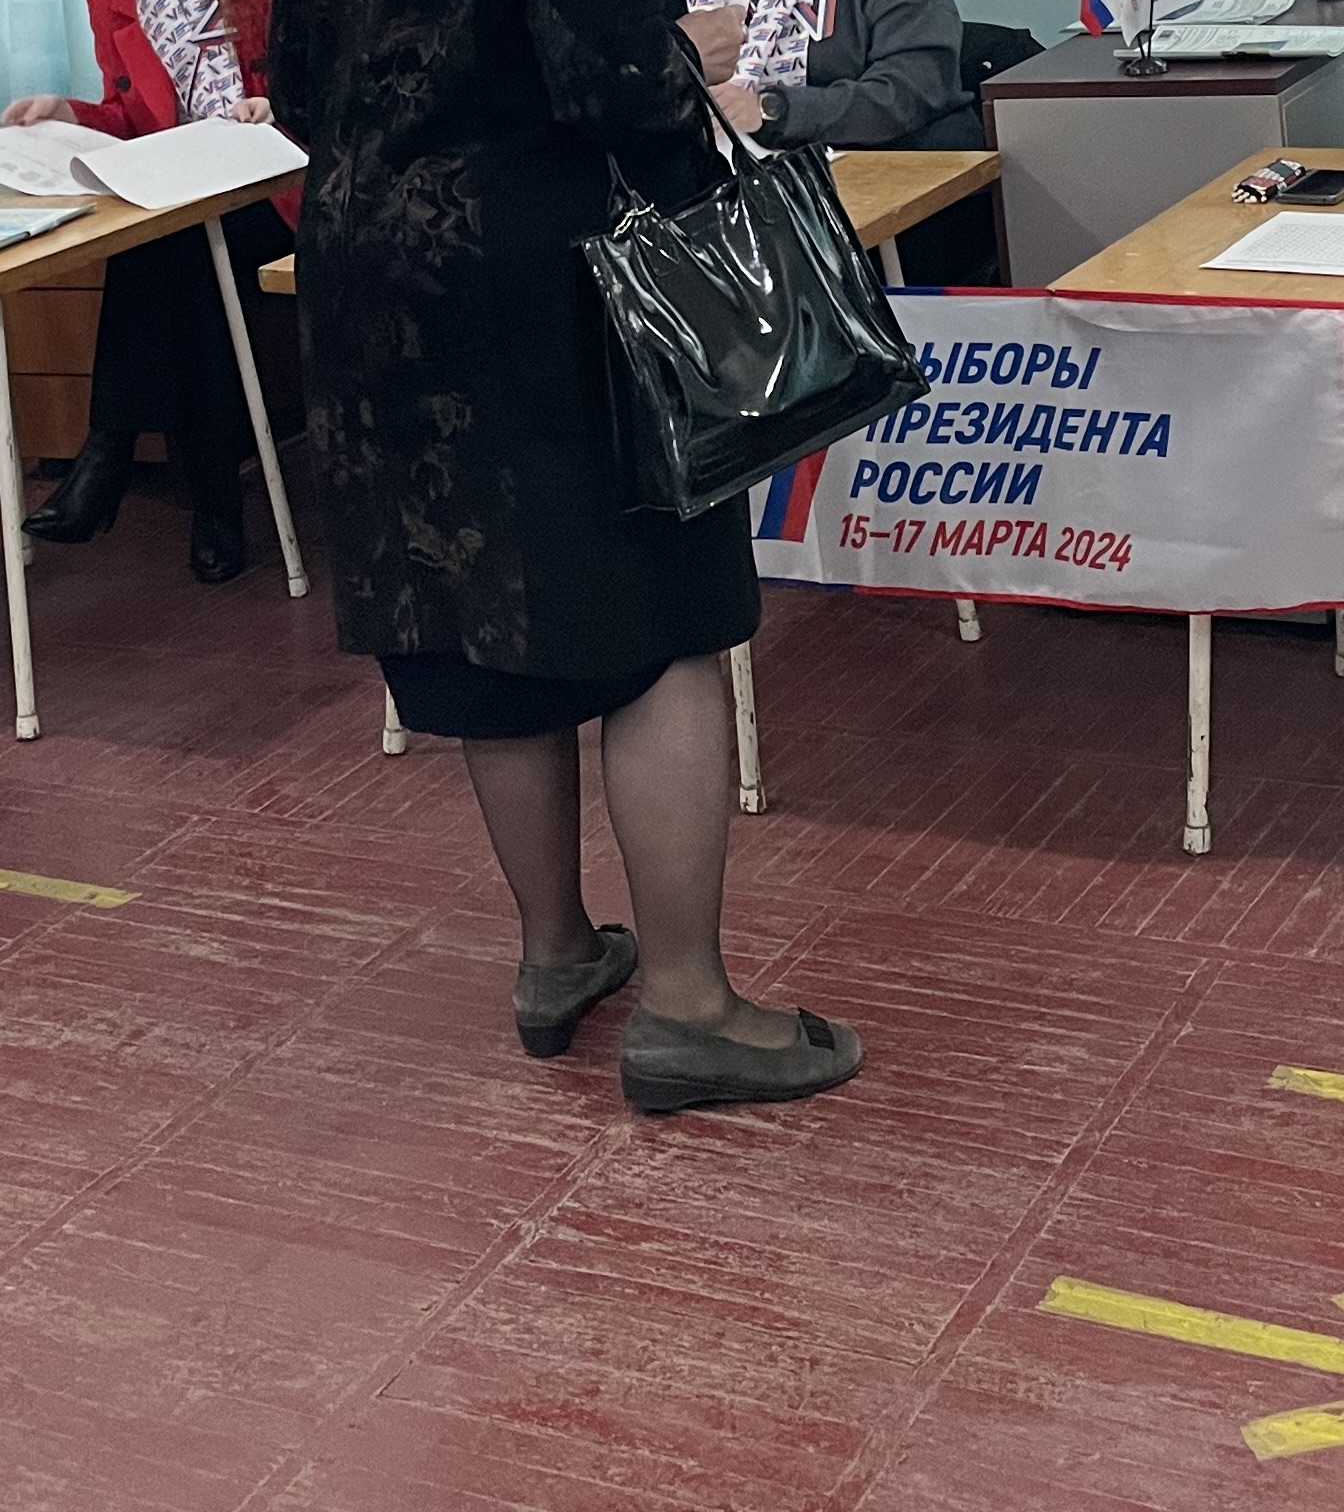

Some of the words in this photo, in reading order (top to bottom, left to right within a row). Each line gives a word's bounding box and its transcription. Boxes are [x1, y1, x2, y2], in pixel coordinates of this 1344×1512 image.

[915, 342, 1102, 390] ЫБОРЫ
[865, 401, 1171, 459] ПРЕЗИДЕНТА
[849, 459, 1043, 505] РОССИИ
[929, 519, 1048, 558] МАРТА
[1054, 526, 1133, 572] 2024
